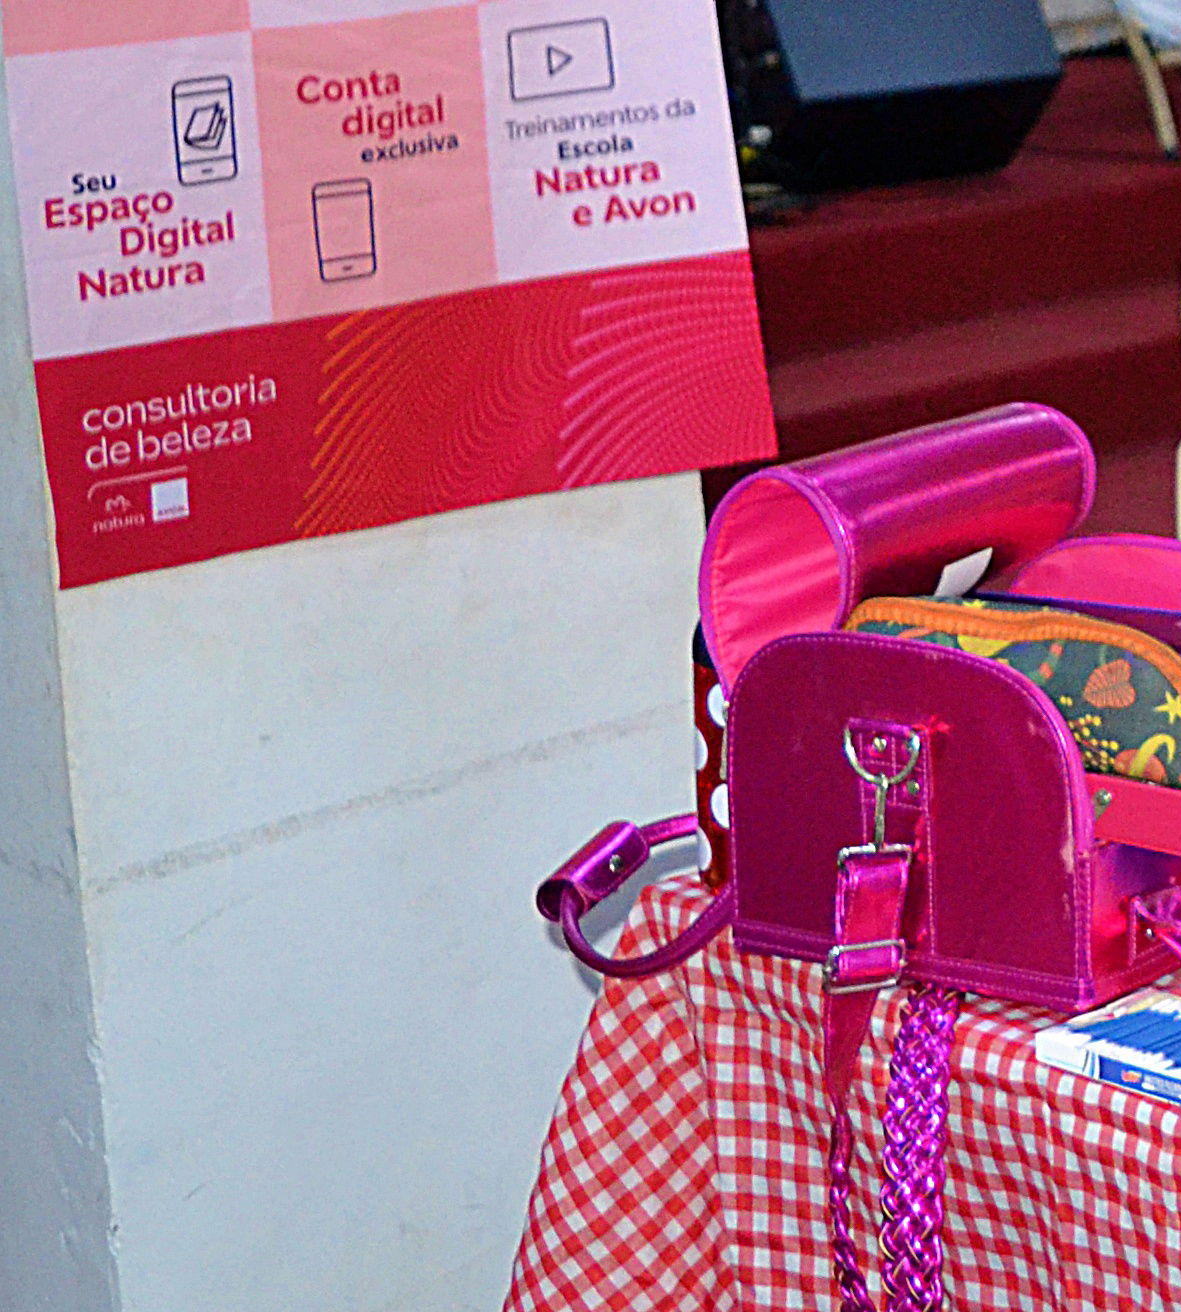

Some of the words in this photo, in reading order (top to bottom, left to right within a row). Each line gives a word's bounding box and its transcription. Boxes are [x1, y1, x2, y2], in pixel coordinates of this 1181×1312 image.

[297, 69, 400, 104] Conta
[341, 94, 444, 139] digital
[505, 103, 659, 140] Treinamentos
[665, 97, 697, 118] da
[360, 132, 460, 163] exclusiva
[558, 134, 634, 161] Escola
[71, 172, 117, 195] Seu
[535, 159, 661, 197] Natura
[44, 190, 173, 231] Espaço
[573, 205, 592, 227] e
[604, 190, 697, 223] Avon
[120, 210, 235, 258] Digital
[78, 260, 205, 301] Natura
[82, 373, 277, 434] consultoria
[85, 436, 131, 470] de
[137, 417, 252, 462] beleza
